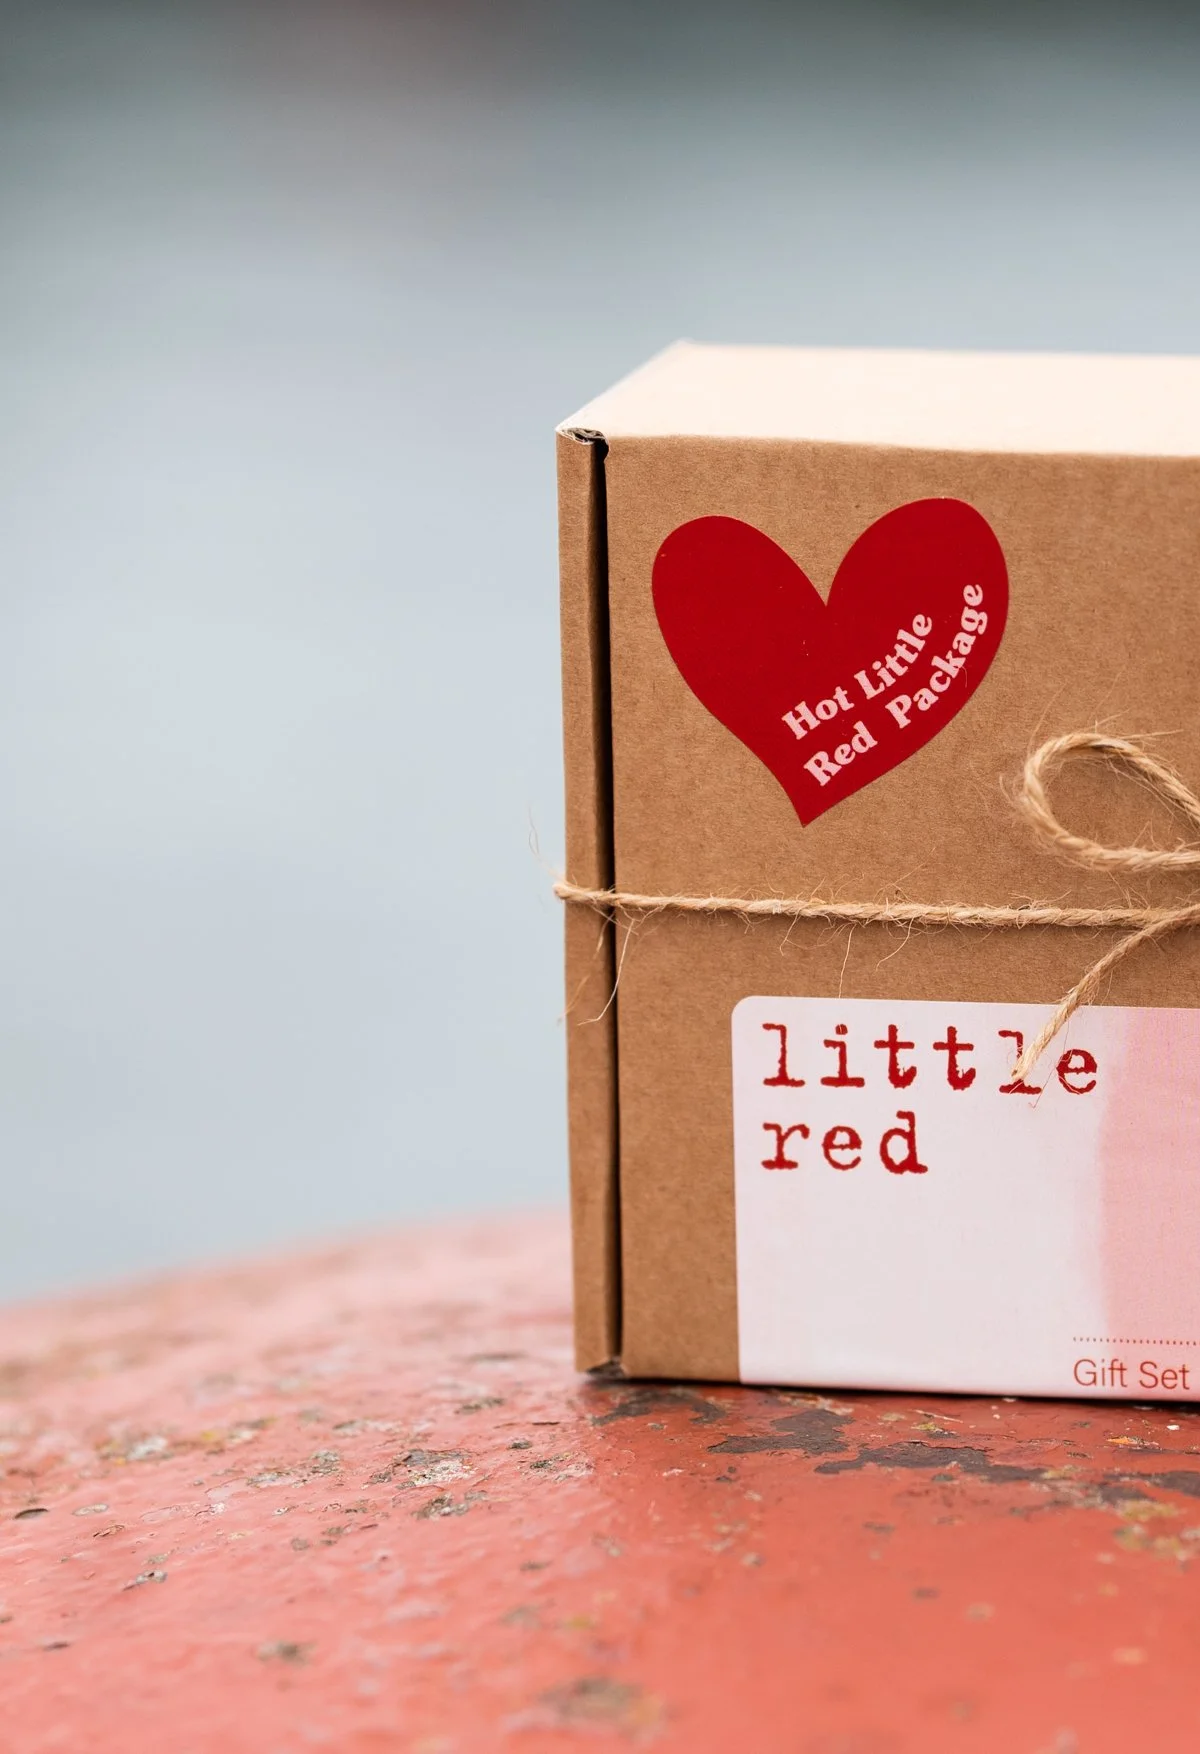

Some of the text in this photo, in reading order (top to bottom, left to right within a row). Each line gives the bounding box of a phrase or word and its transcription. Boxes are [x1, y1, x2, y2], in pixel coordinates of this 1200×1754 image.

[781, 613, 933, 740] Hot Little
[803, 583, 988, 786] Red Package
[761, 1110, 929, 1175] red
[1073, 1358, 1191, 1390] Gift Set
